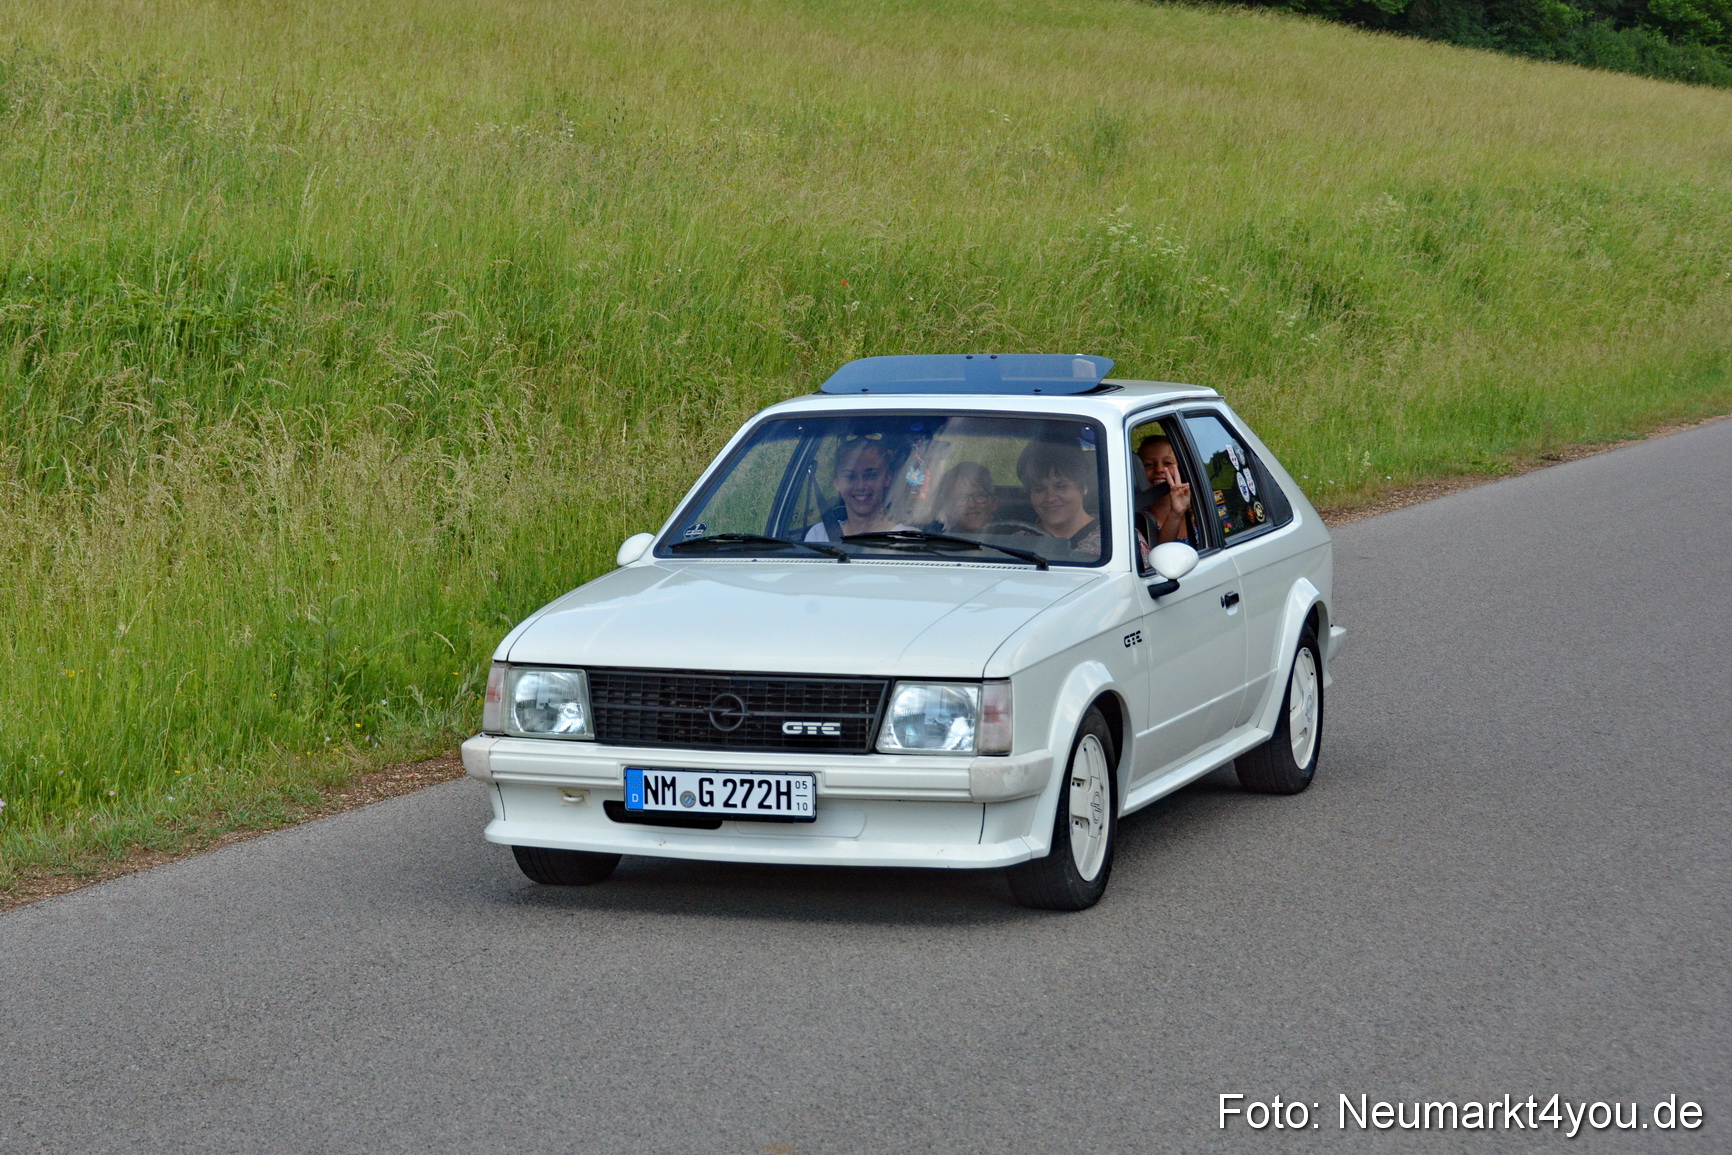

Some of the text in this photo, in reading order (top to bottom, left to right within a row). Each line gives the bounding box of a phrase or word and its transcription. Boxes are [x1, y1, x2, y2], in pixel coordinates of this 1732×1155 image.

[1123, 629, 1143, 648] GTE
[782, 721, 841, 735] GTE
[643, 775, 677, 806] NM
[795, 780, 808, 790] 05
[631, 793, 639, 803] D
[796, 802, 808, 811] 10
